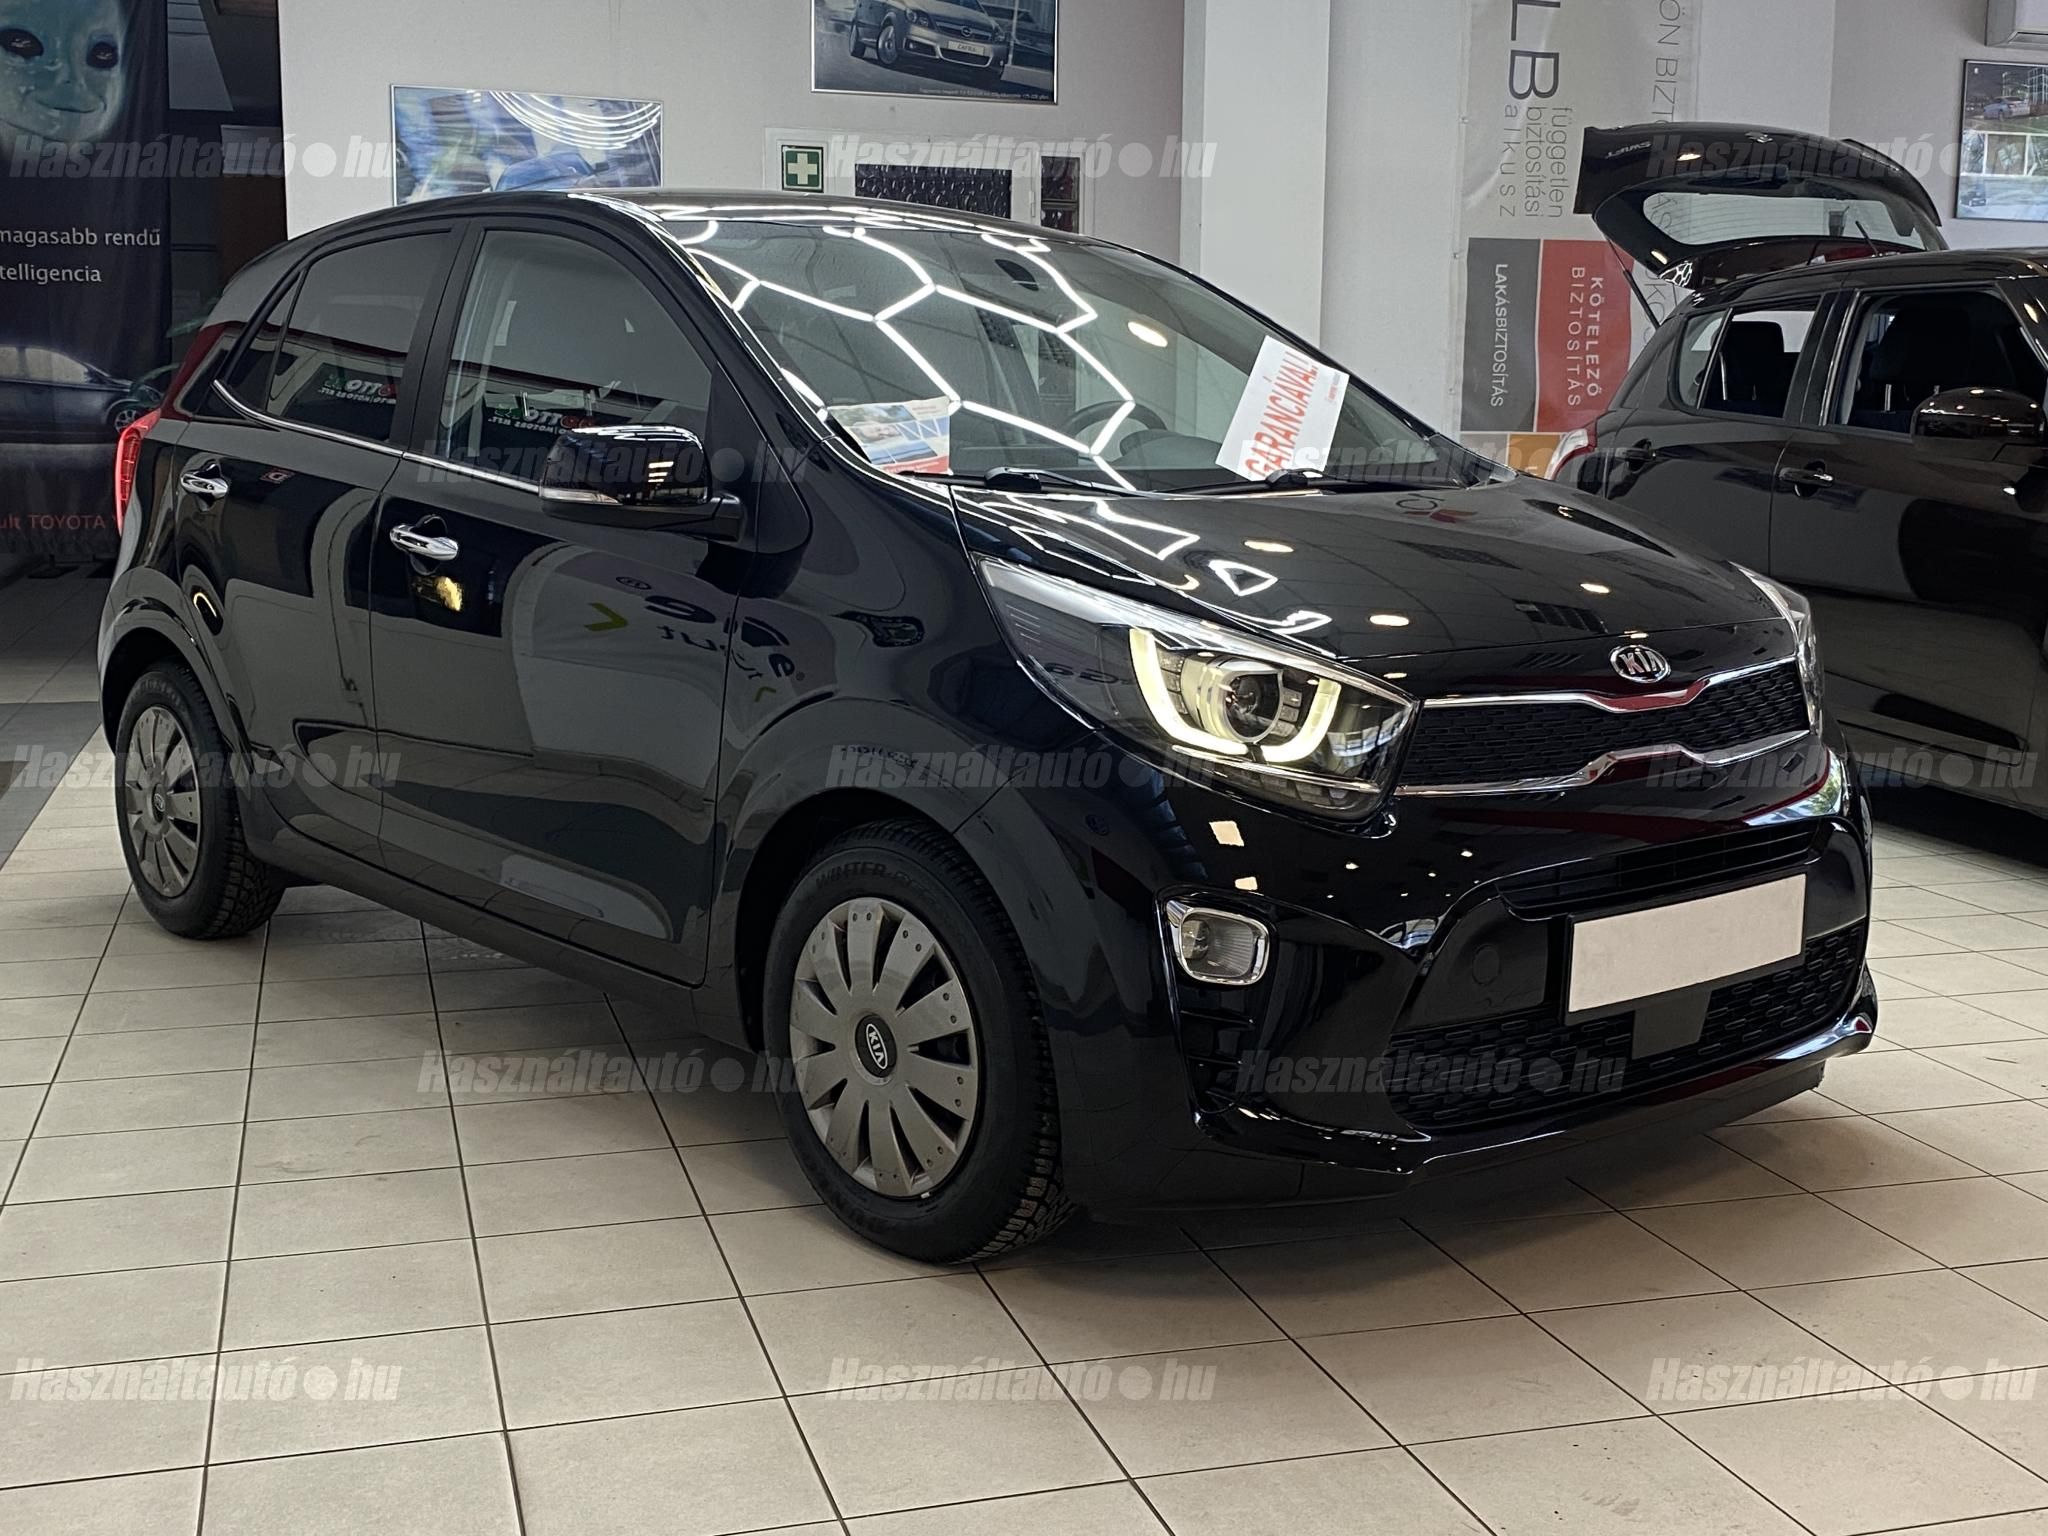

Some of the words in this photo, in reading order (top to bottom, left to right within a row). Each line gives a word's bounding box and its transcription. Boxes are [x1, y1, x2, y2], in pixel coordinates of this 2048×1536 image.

[1650, 58, 1678, 124] BIZT
[1499, 104, 1521, 217] alkusz
[1524, 106, 1548, 217] biztosítási
[1546, 106, 1573, 218] független
[0, 263, 103, 286] telligencia
[105, 228, 161, 247] rendű
[1490, 263, 1509, 407] LAKÁSBIZTOSÍTÁS
[1567, 267, 1586, 406] BIZTOSÍTÁS
[1586, 276, 1604, 397] KÖTELEZŐ
[27, 513, 107, 531] TOYOTA
[1616, 648, 1666, 677] KIA
[868, 1028, 886, 1066] KIA
